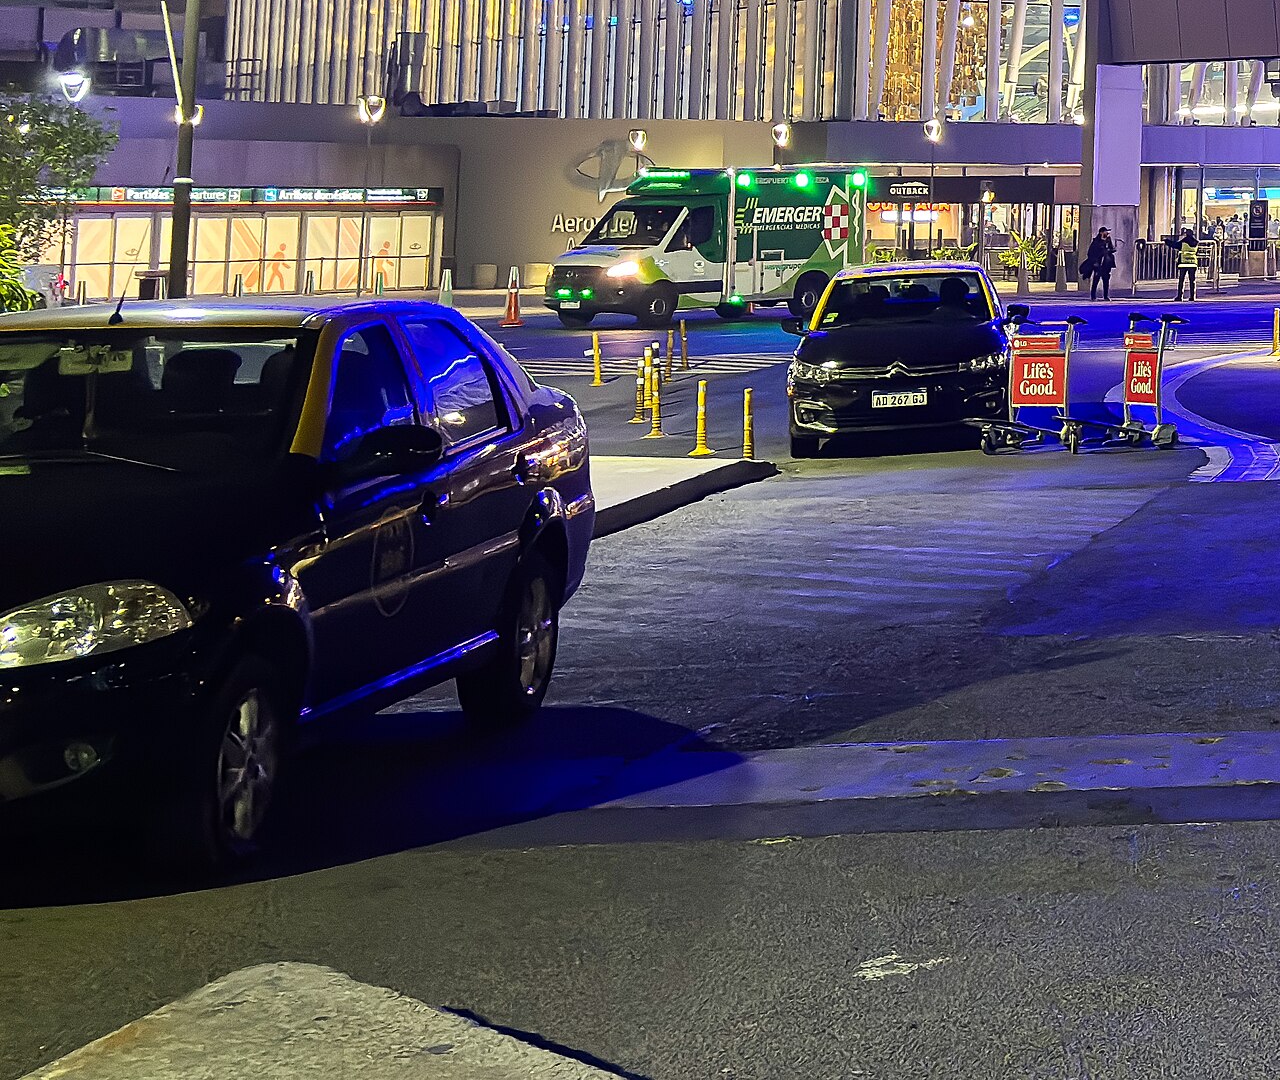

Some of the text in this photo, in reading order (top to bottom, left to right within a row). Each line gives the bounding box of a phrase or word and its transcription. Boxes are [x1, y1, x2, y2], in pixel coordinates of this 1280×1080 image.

[889, 186, 929, 195] OUTBACK
[752, 206, 822, 223] EMERGER
[1023, 361, 1054, 379] Life's
[1133, 360, 1152, 378] Life's
[1019, 380, 1057, 396] Good.
[1130, 378, 1154, 395] Good.
[876, 396, 888, 406] AD
[891, 395, 909, 405] 267
